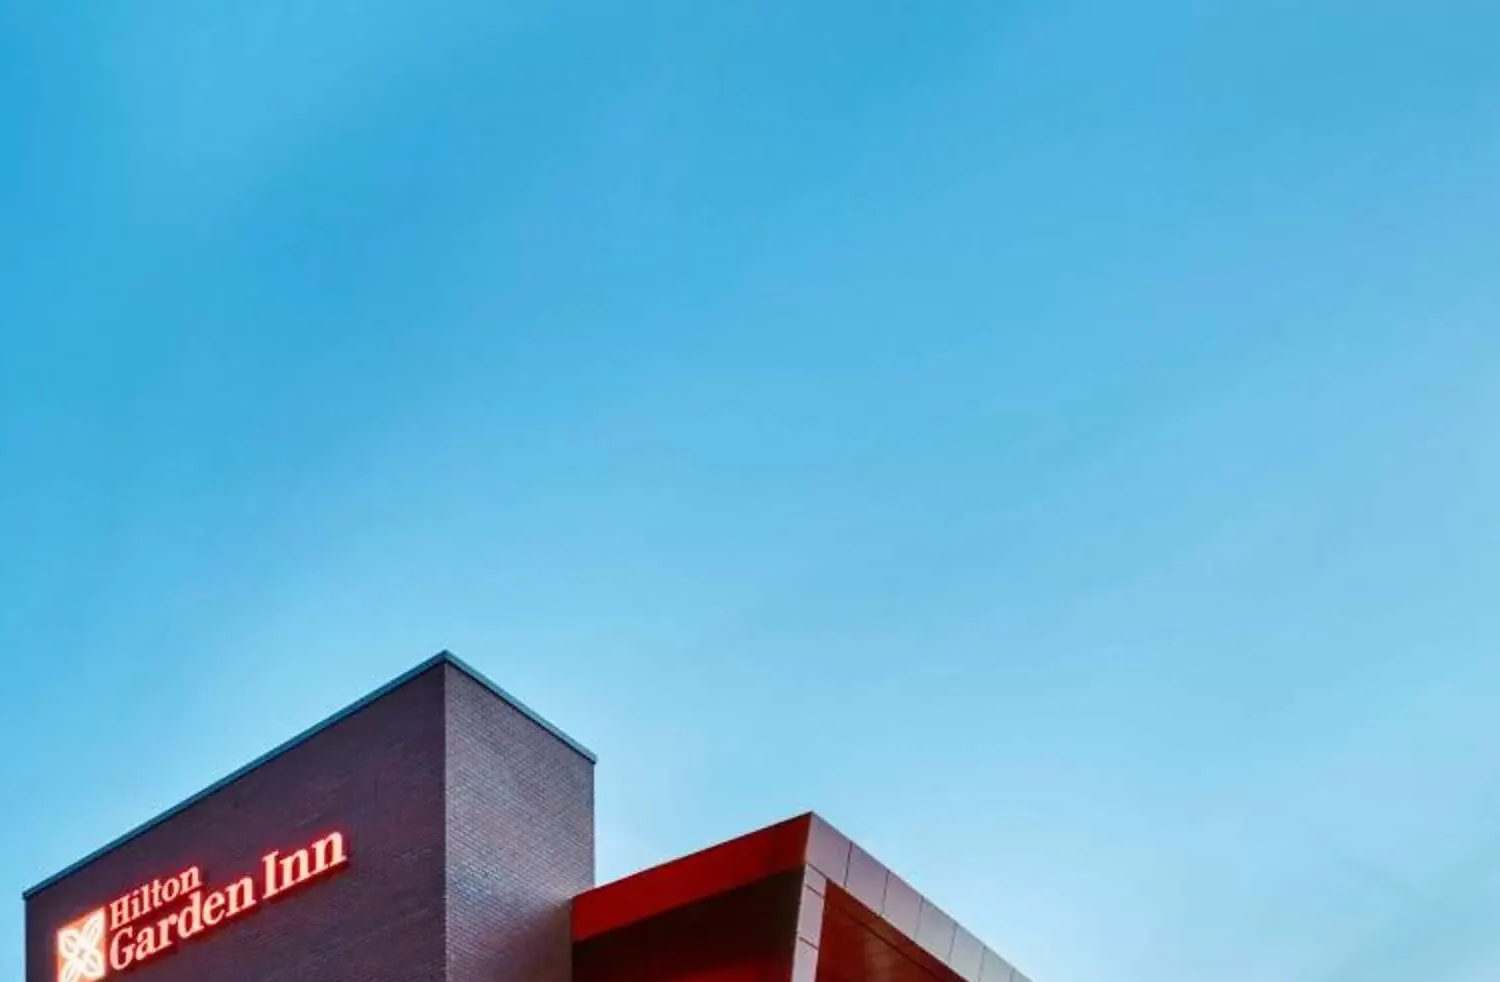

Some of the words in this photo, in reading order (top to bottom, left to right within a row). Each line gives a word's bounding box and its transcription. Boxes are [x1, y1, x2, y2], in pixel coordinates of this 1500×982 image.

[109, 865, 202, 931] Hilton
[109, 874, 256, 971] Garden
[261, 830, 347, 900] Inn
